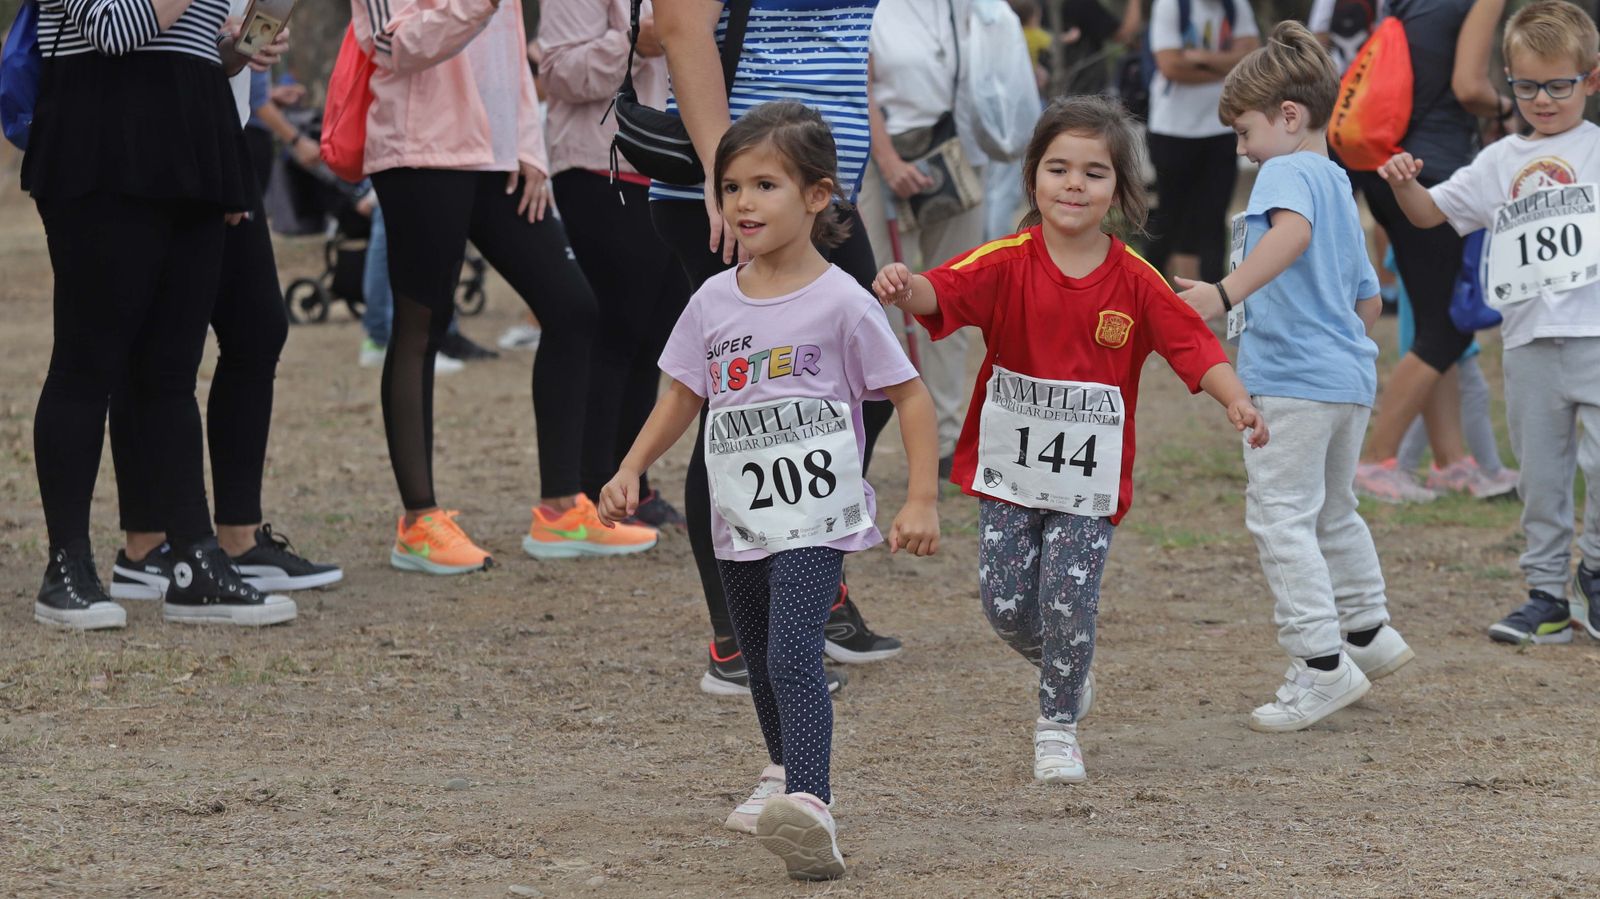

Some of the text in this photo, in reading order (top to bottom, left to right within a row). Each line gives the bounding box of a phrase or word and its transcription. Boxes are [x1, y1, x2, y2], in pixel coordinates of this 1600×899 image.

[1515, 223, 1582, 268] 180
[706, 335, 752, 360] SUPER
[709, 344, 821, 394] SISTER
[995, 394, 1041, 418] POPULAR
[1044, 410, 1060, 421] DE
[1061, 412, 1078, 423] LA
[1012, 376, 1118, 413] MILLA
[725, 399, 843, 440] MILLA
[711, 438, 761, 455] POPULAR
[763, 434, 782, 447] DE
[785, 430, 801, 443] LA
[1012, 426, 1098, 478] 144
[741, 449, 837, 511] 208
